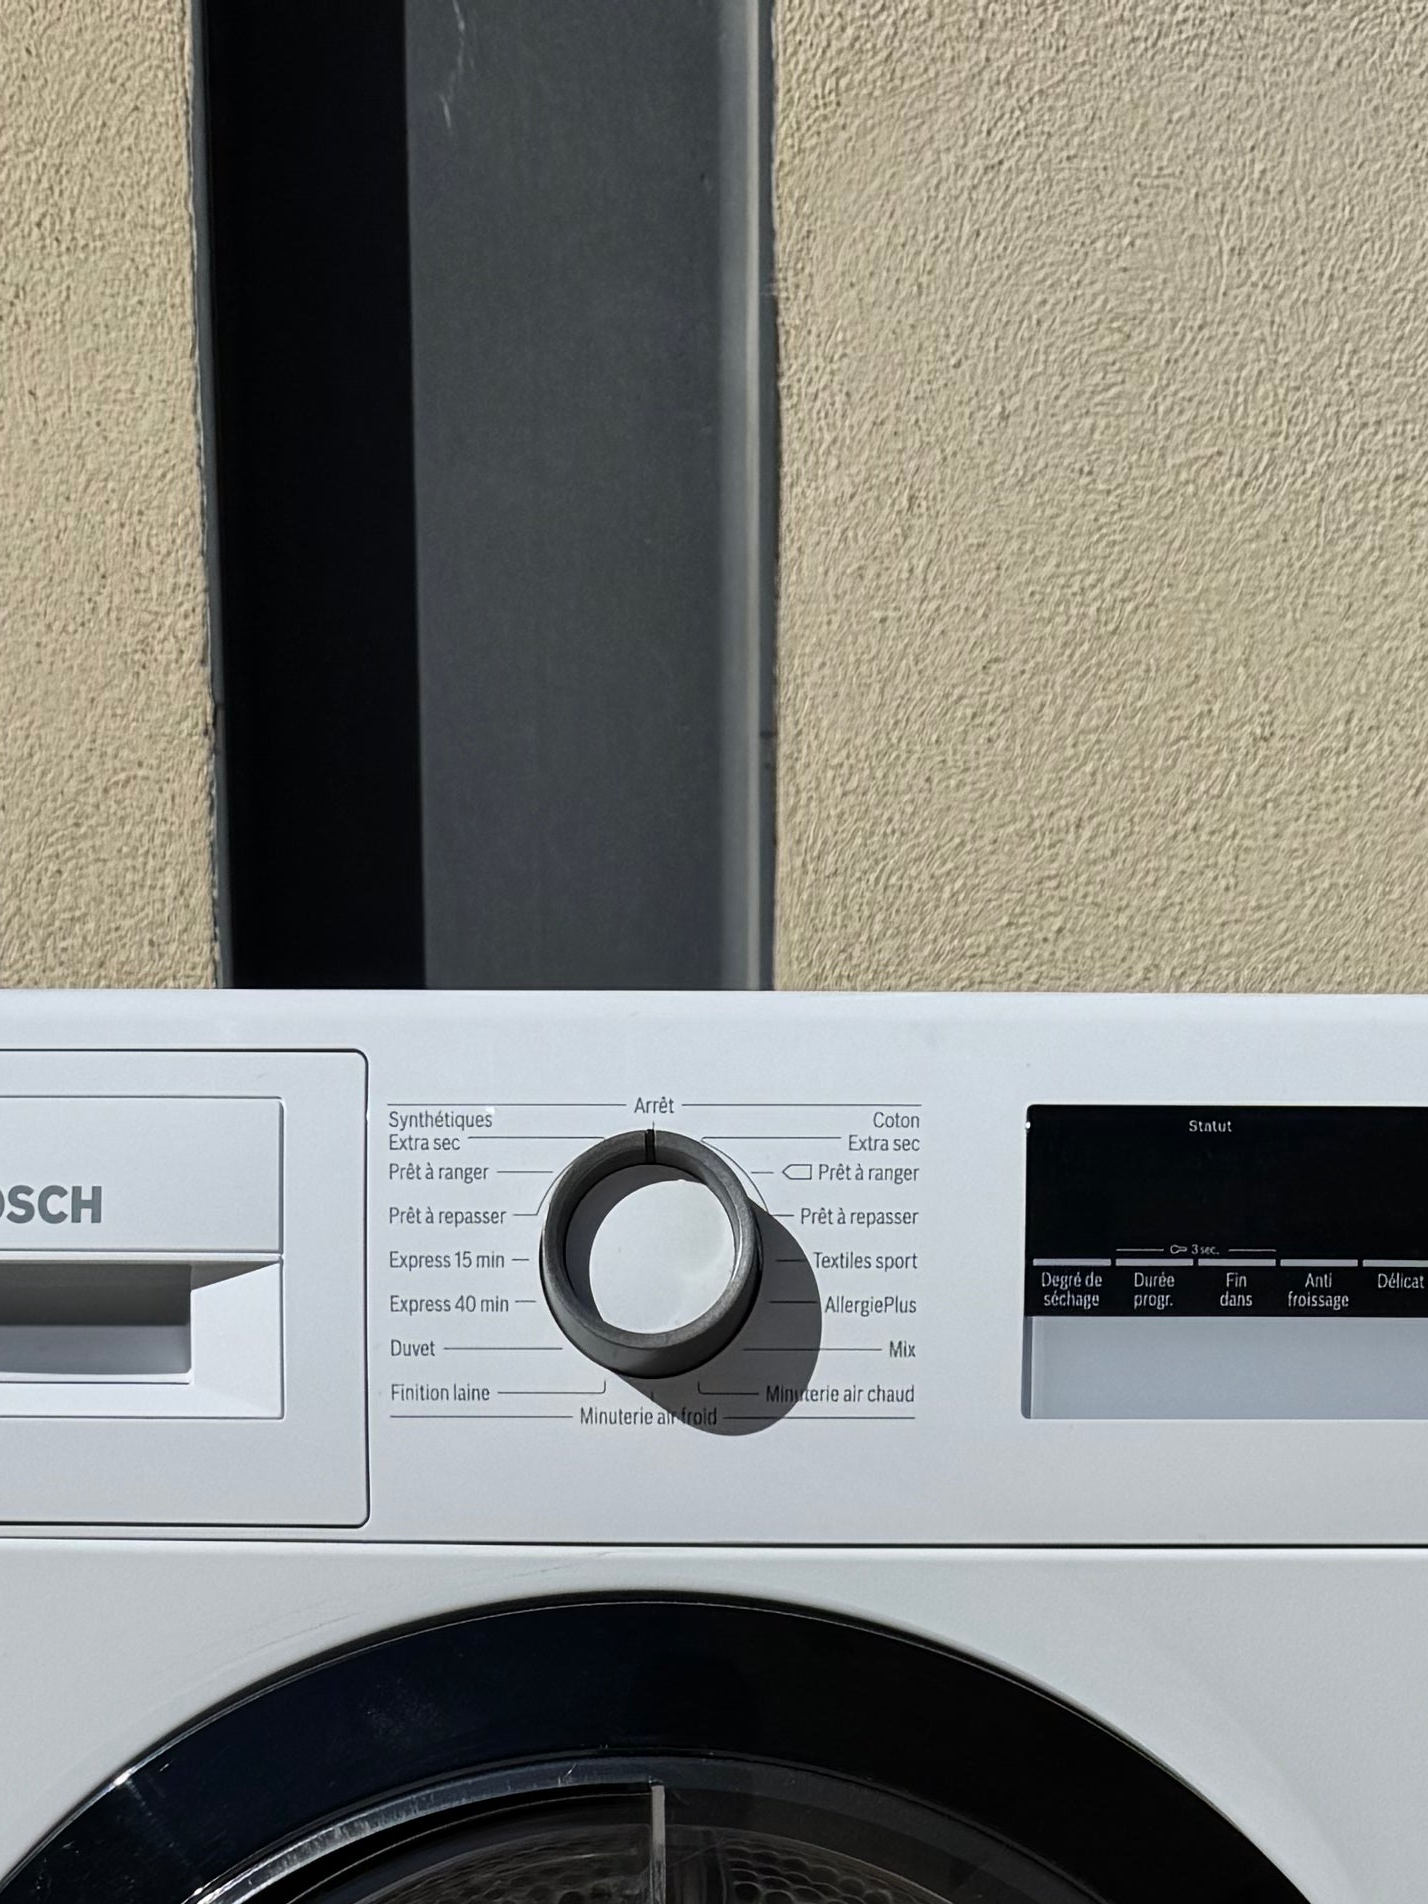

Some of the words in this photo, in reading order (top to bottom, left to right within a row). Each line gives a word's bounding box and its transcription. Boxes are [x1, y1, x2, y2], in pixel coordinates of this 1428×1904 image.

[633, 1096, 675, 1114] Arrêt
[388, 1110, 493, 1131] Synthétiques
[872, 1111, 921, 1129] Coton
[1188, 1118, 1232, 1133] Statut
[388, 1134, 429, 1152] Extra
[433, 1138, 461, 1152] sec
[847, 1135, 889, 1152] Extra
[893, 1138, 921, 1152] sec
[388, 1162, 422, 1181] Prêt
[423, 1162, 435, 1181] à
[438, 1167, 490, 1184] ranger
[817, 1162, 850, 1181] Prêt
[854, 1162, 865, 1181] à
[869, 1167, 920, 1185] ranger
[388, 1206, 421, 1225] Prêt
[424, 1207, 435, 1225] à
[439, 1211, 507, 1229] repasser
[799, 1207, 832, 1226] Prêt
[835, 1208, 846, 1226] à
[850, 1212, 920, 1230] repasser
[1190, 1243, 1199, 1256] 3
[388, 1250, 451, 1273] Express
[455, 1250, 472, 1268] 15
[475, 1251, 506, 1268] min
[813, 1251, 871, 1270] Textiles
[874, 1253, 918, 1274] sport
[1041, 1270, 1082, 1290] Degré
[1085, 1271, 1103, 1289] de
[1133, 1271, 1175, 1290] Durée
[1225, 1271, 1247, 1289] Fin
[1304, 1271, 1333, 1290] Anti
[1377, 1271, 1425, 1290] Délicat
[389, 1295, 452, 1317] Express
[454, 1295, 476, 1312] 40
[479, 1295, 509, 1312] min
[824, 1295, 918, 1319] AllergiePlus
[1043, 1288, 1101, 1310] séchage
[1133, 1293, 1174, 1311] progr.
[1219, 1290, 1253, 1308] dans
[1287, 1290, 1350, 1311] froissage
[390, 1340, 436, 1358] Duvet
[889, 1341, 917, 1358] Mix
[390, 1384, 448, 1402] Finition
[452, 1384, 491, 1402] laine
[765, 1384, 840, 1403] Minuterie
[843, 1384, 865, 1403] air
[868, 1384, 915, 1403] chaud
[579, 1407, 654, 1426] Minuterie
[657, 1407, 678, 1426] air
[681, 1407, 718, 1427] froid
